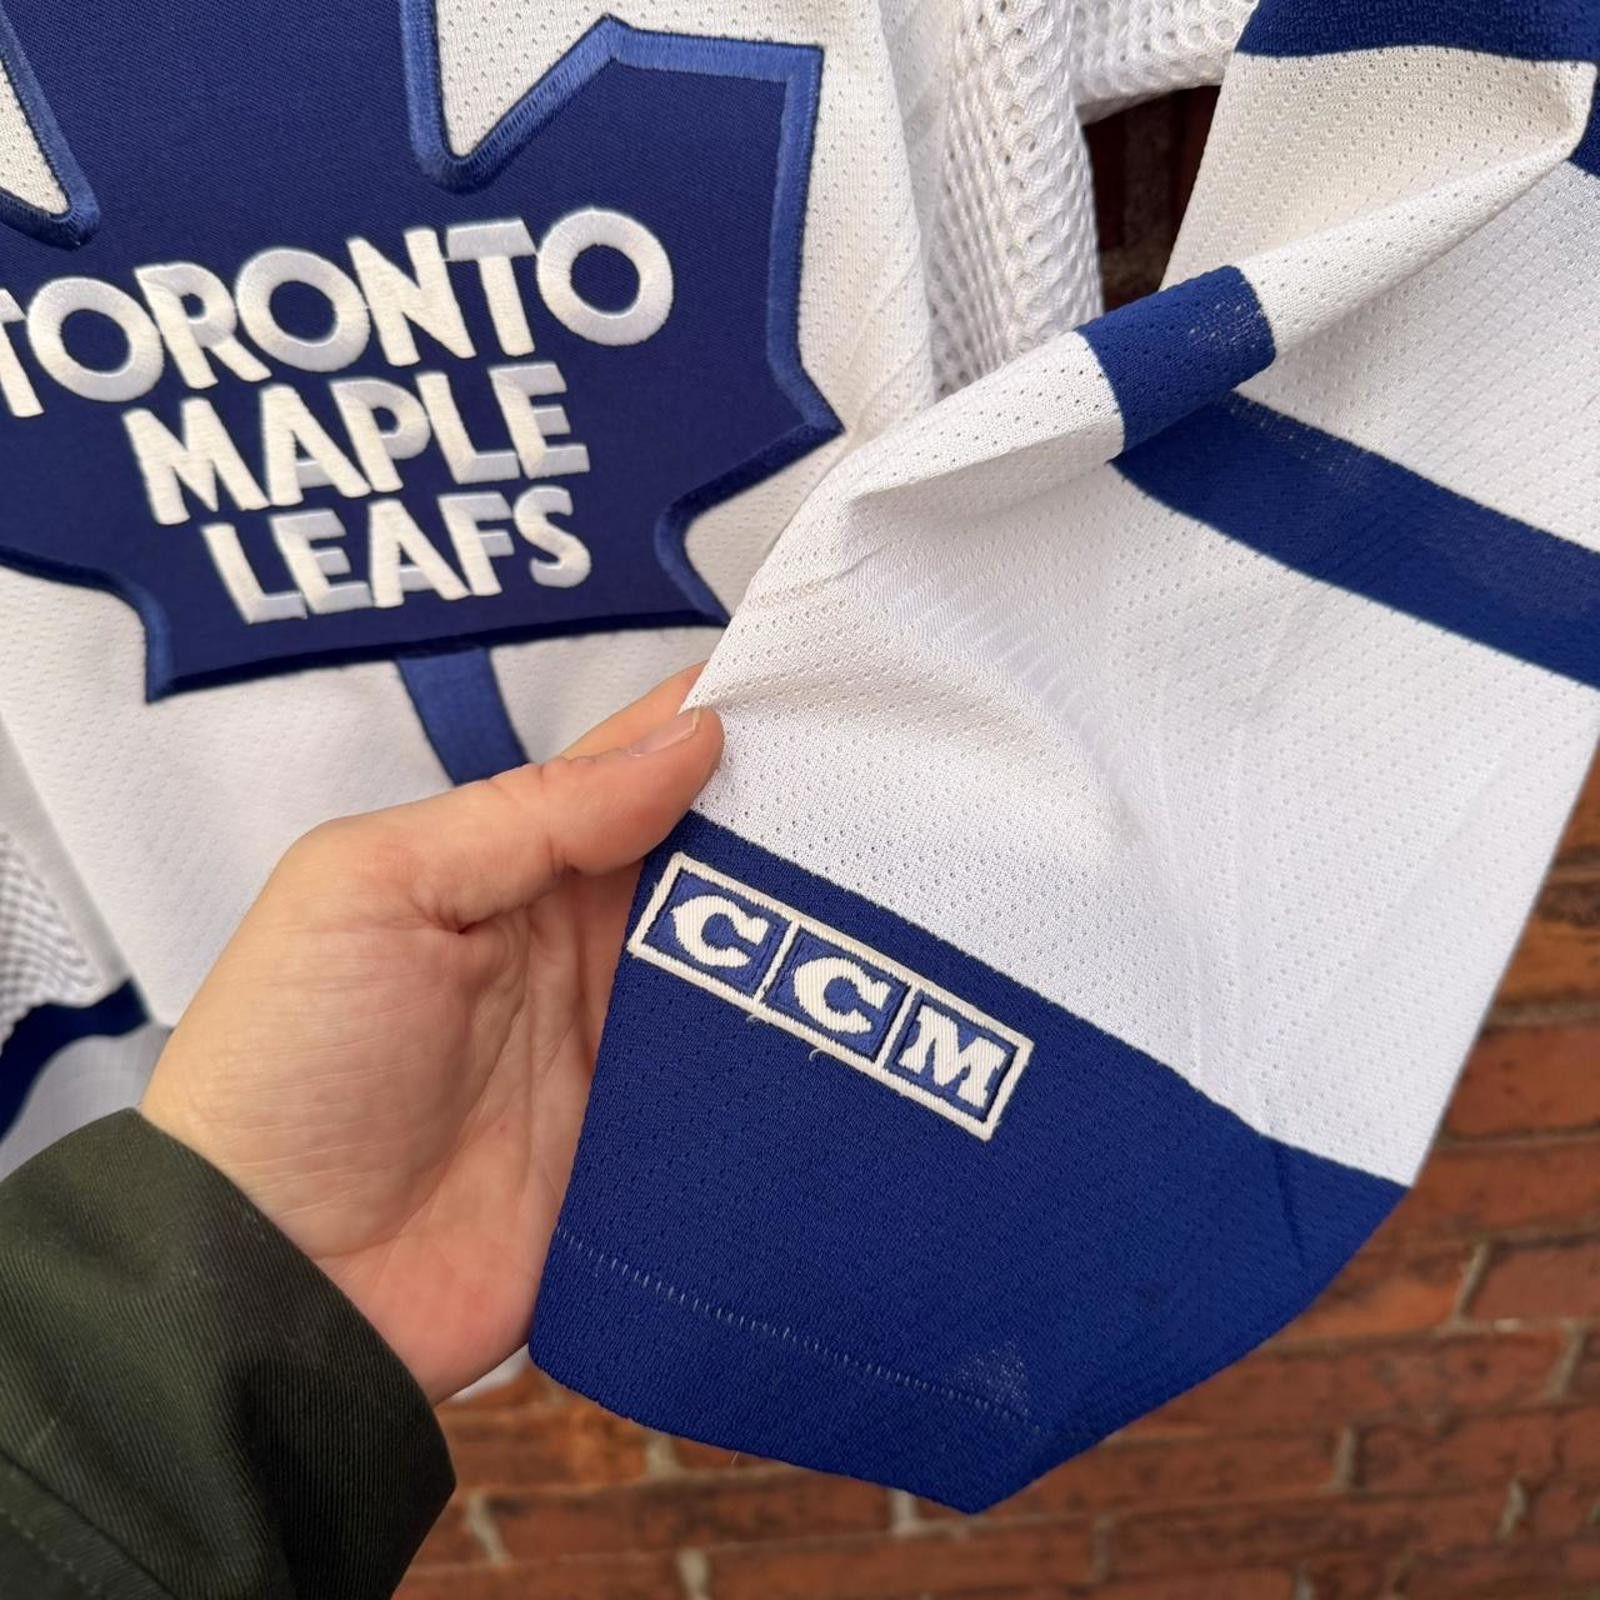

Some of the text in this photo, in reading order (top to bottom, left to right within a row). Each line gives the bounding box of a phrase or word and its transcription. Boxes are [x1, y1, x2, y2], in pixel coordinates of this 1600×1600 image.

[122, 361, 590, 525] MAPLE
[201, 485, 592, 624] LEAFS
[670, 895, 1008, 1108] CCM
